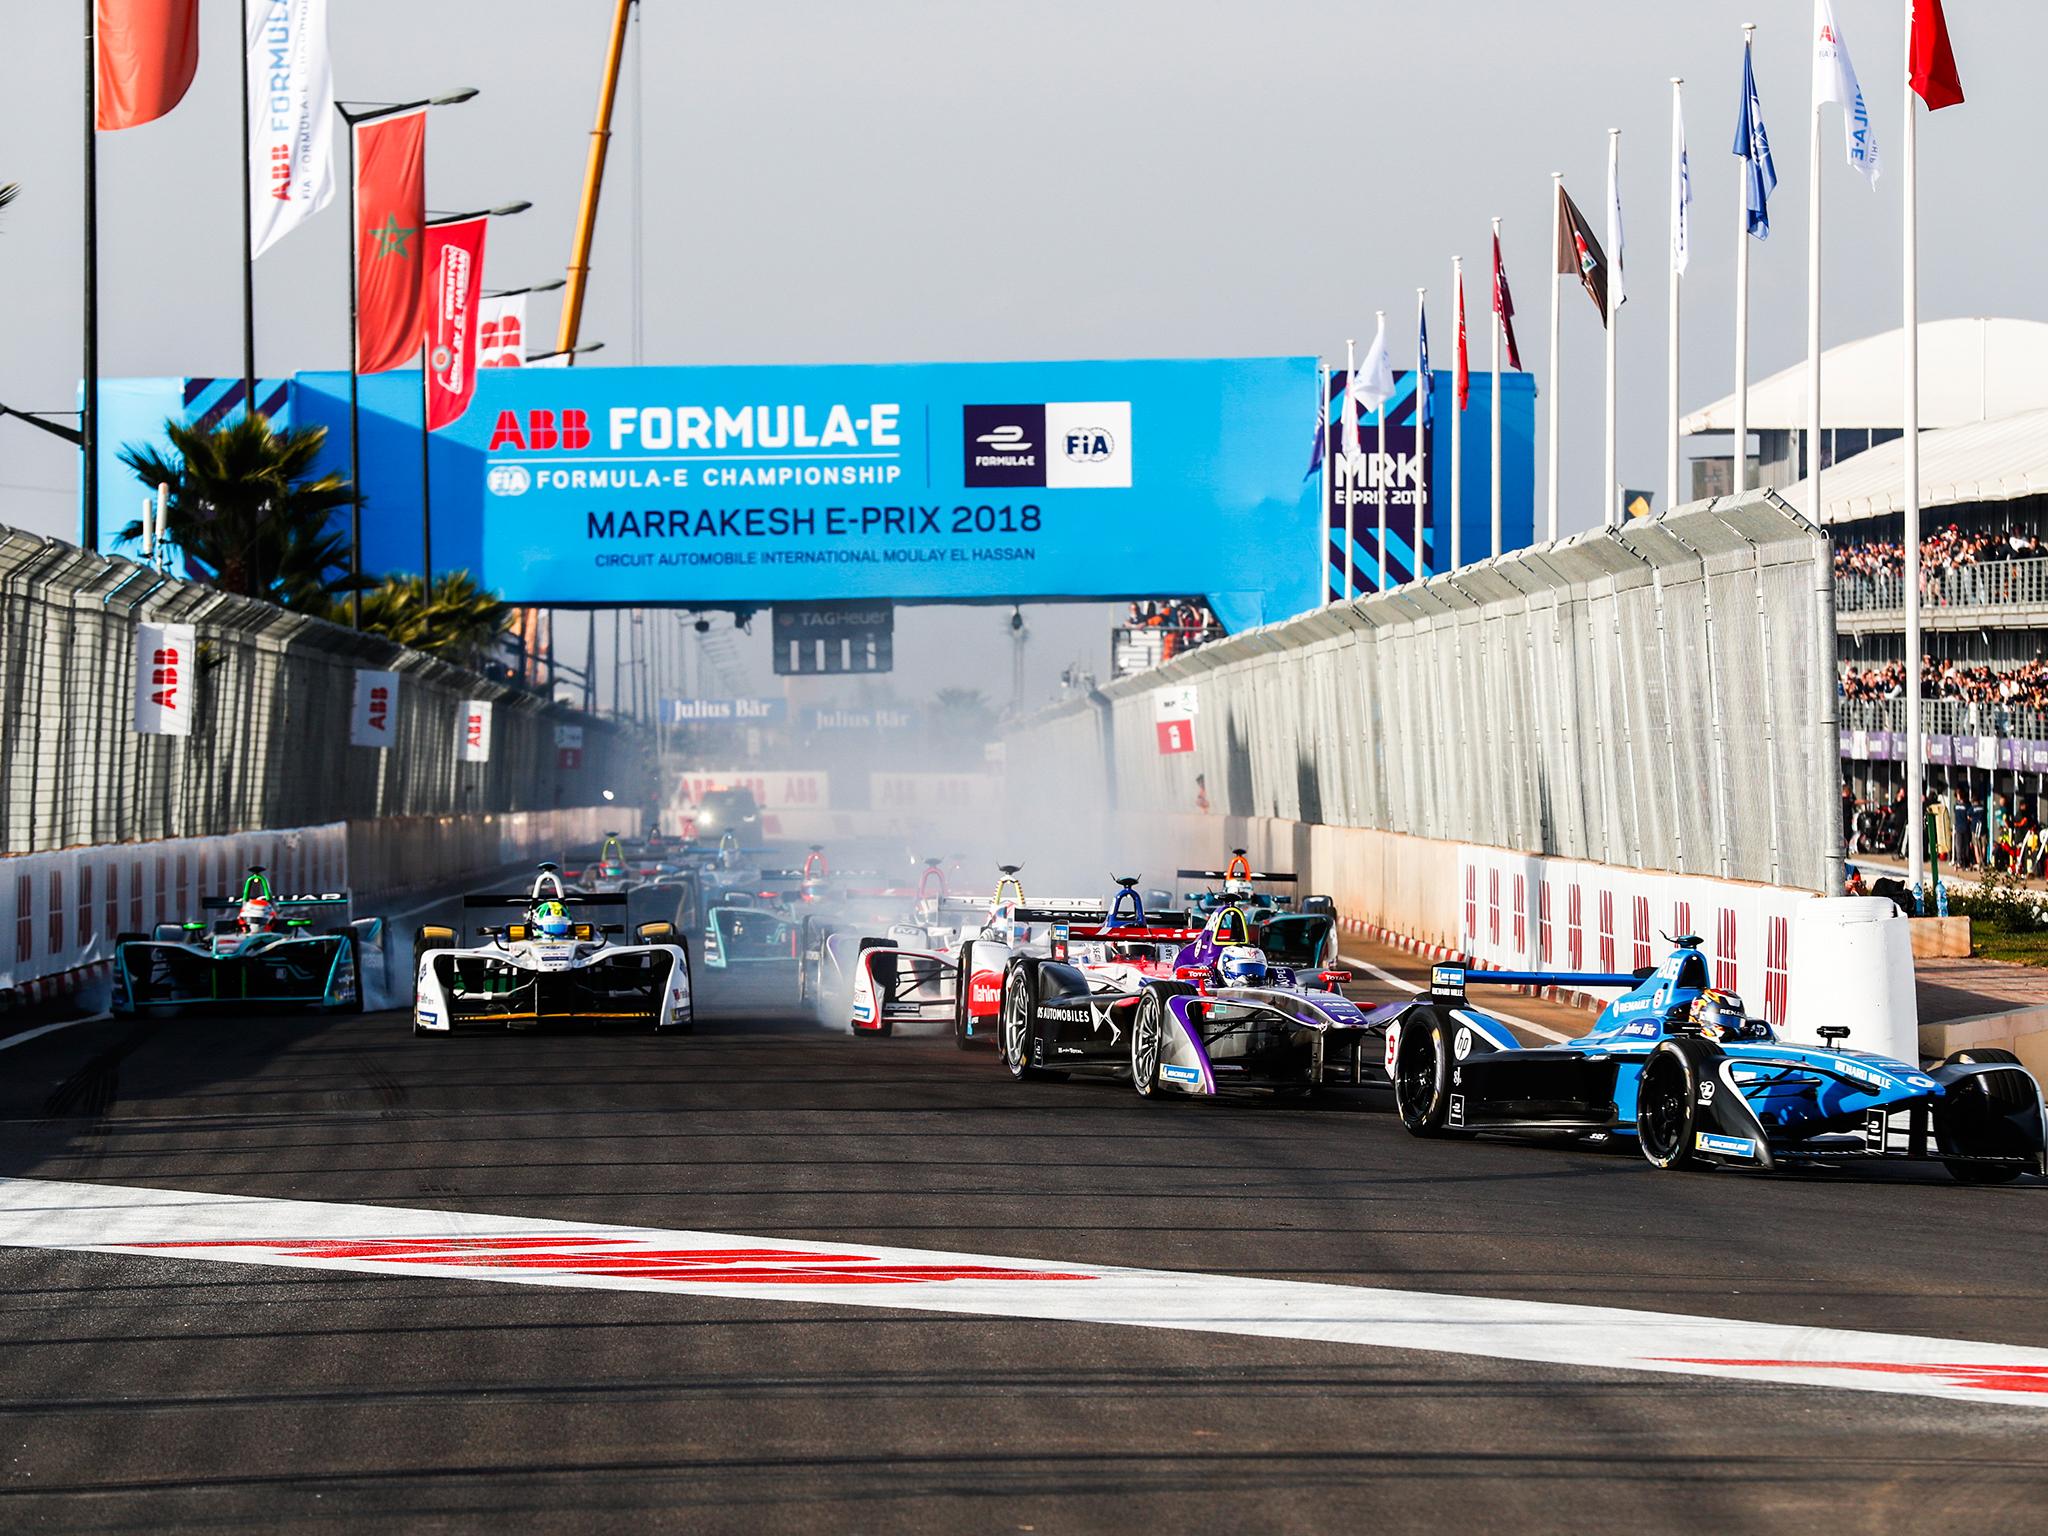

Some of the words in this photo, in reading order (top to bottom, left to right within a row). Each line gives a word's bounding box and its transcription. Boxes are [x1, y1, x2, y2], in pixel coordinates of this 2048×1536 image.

[272, 144, 291, 201] ABB
[488, 409, 592, 450] ABB
[609, 404, 900, 450] FORMULA-E
[975, 456, 1035, 466] FORMULA-E
[1335, 453, 1427, 487] MRK
[536, 469, 688, 489] FORMULA-E
[703, 465, 901, 486] CHAMPIONSHIP
[588, 508, 814, 538] MARRAKESH
[826, 506, 941, 535] E-PRIX
[952, 504, 1041, 532] 2018
[595, 553, 655, 567] CIRCUIT
[658, 551, 756, 567] AUTOMOBILE
[761, 549, 880, 565] INTERNATIONAL
[884, 549, 947, 562] MOULAY
[952, 549, 969, 561] EL
[972, 547, 1035, 561] HASSAN
[152, 648, 178, 709] ABB
[369, 687, 389, 730] ABB
[674, 700, 730, 721] Julius
[736, 699, 773, 717] Bär
[816, 711, 870, 730] Julius
[467, 715, 481, 747] ABB
[1043, 1007, 1089, 1022] AUTOMOBILES
[1619, 1000, 1650, 1012] RENAULT
[1835, 1060, 1867, 1080] RICHARD
[1868, 1072, 1893, 1090] MILLE
